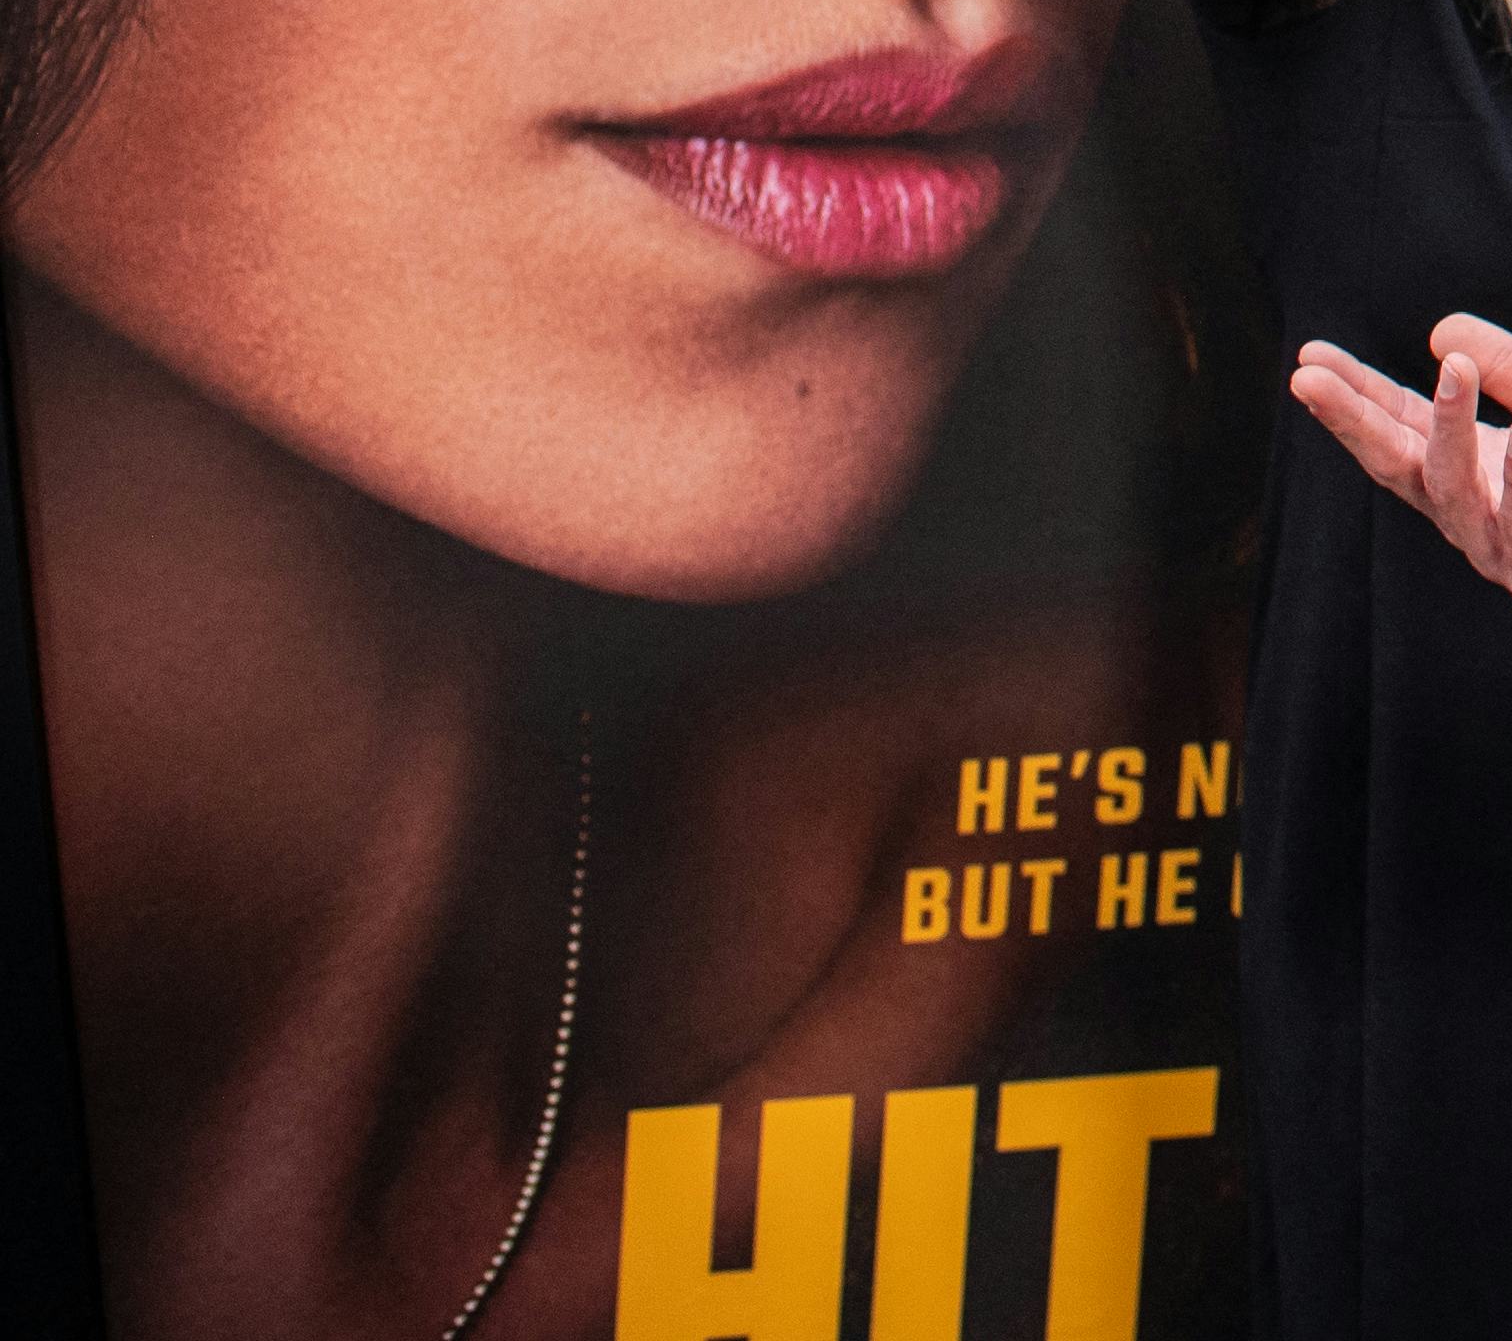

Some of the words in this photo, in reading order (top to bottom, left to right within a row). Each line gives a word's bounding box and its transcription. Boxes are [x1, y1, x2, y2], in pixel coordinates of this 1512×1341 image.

[956, 745, 1146, 837] HE'S
[902, 859, 1068, 945] BUT
[1096, 847, 1200, 931] HE
[614, 1065, 1220, 1341] HIT
